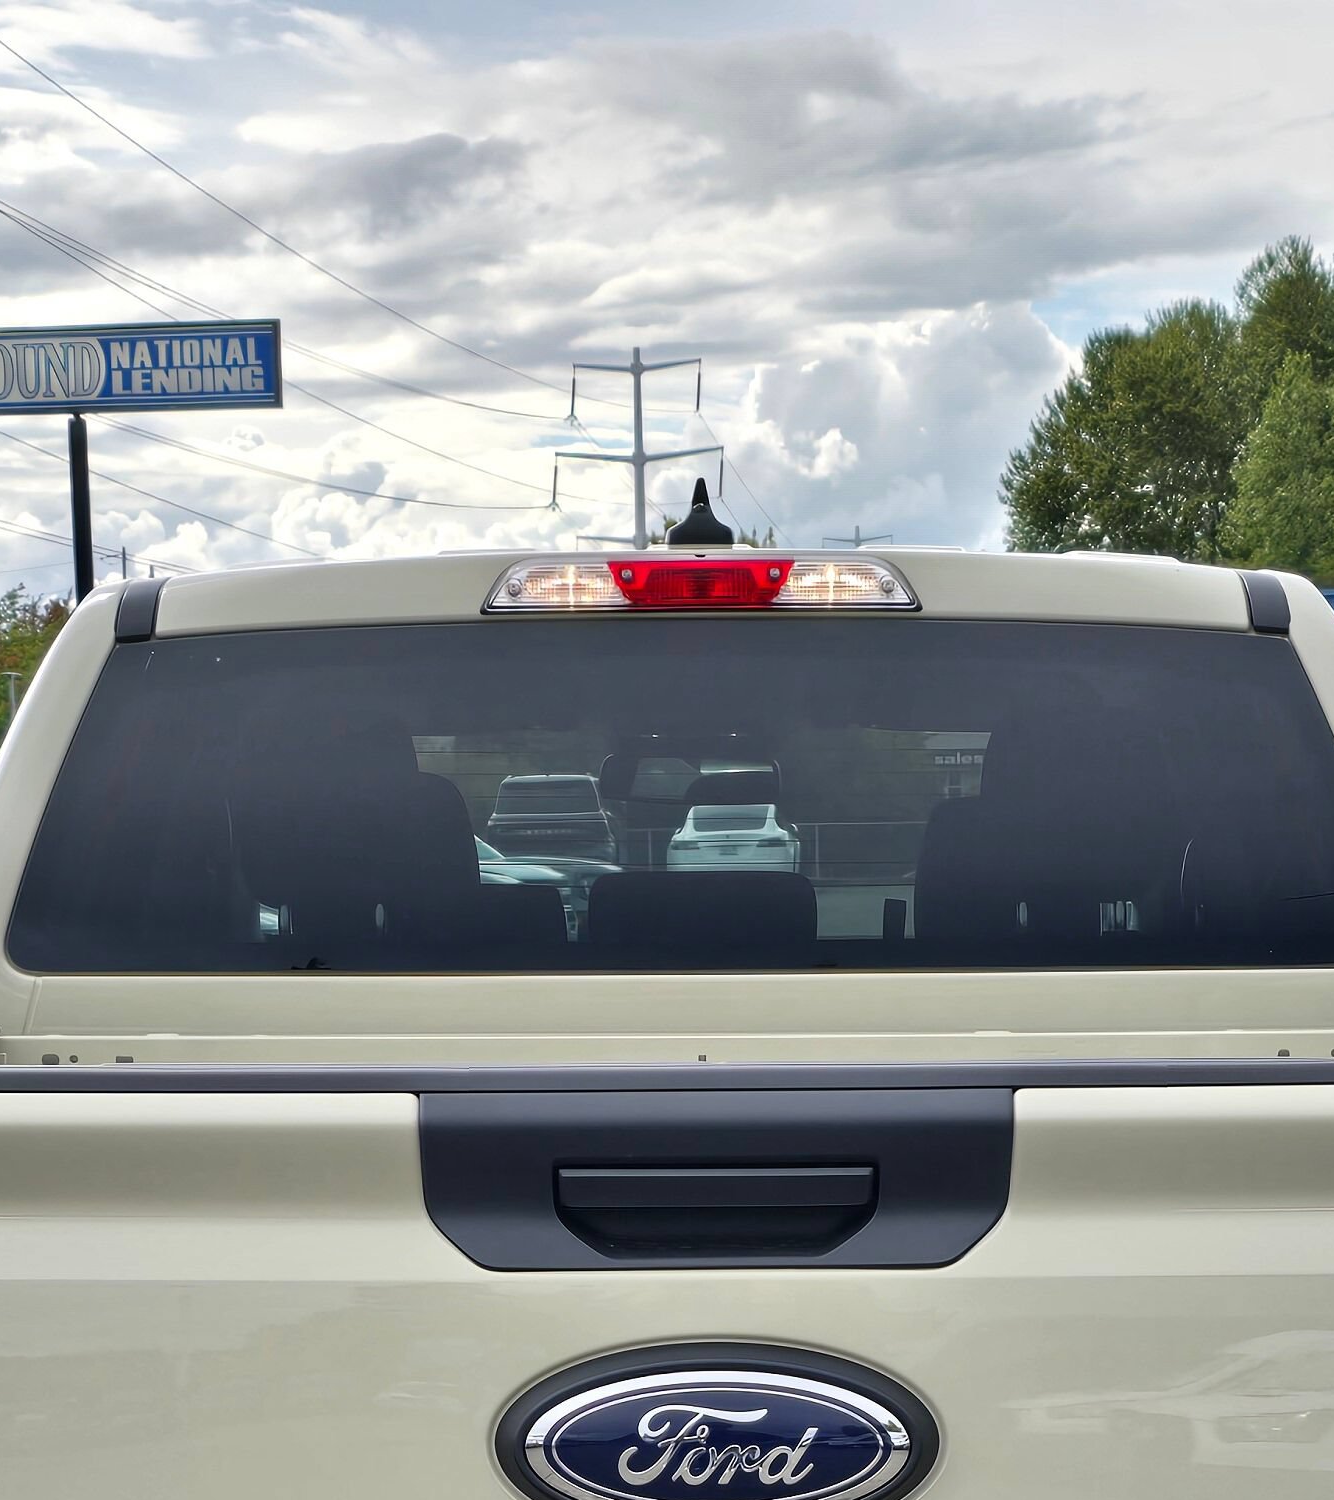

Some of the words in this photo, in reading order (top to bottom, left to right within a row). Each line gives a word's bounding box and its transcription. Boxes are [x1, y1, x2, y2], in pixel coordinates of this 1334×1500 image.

[110, 337, 263, 370] NATIONAL
[112, 366, 265, 395] LENDING
[617, 1404, 818, 1486] Ford
